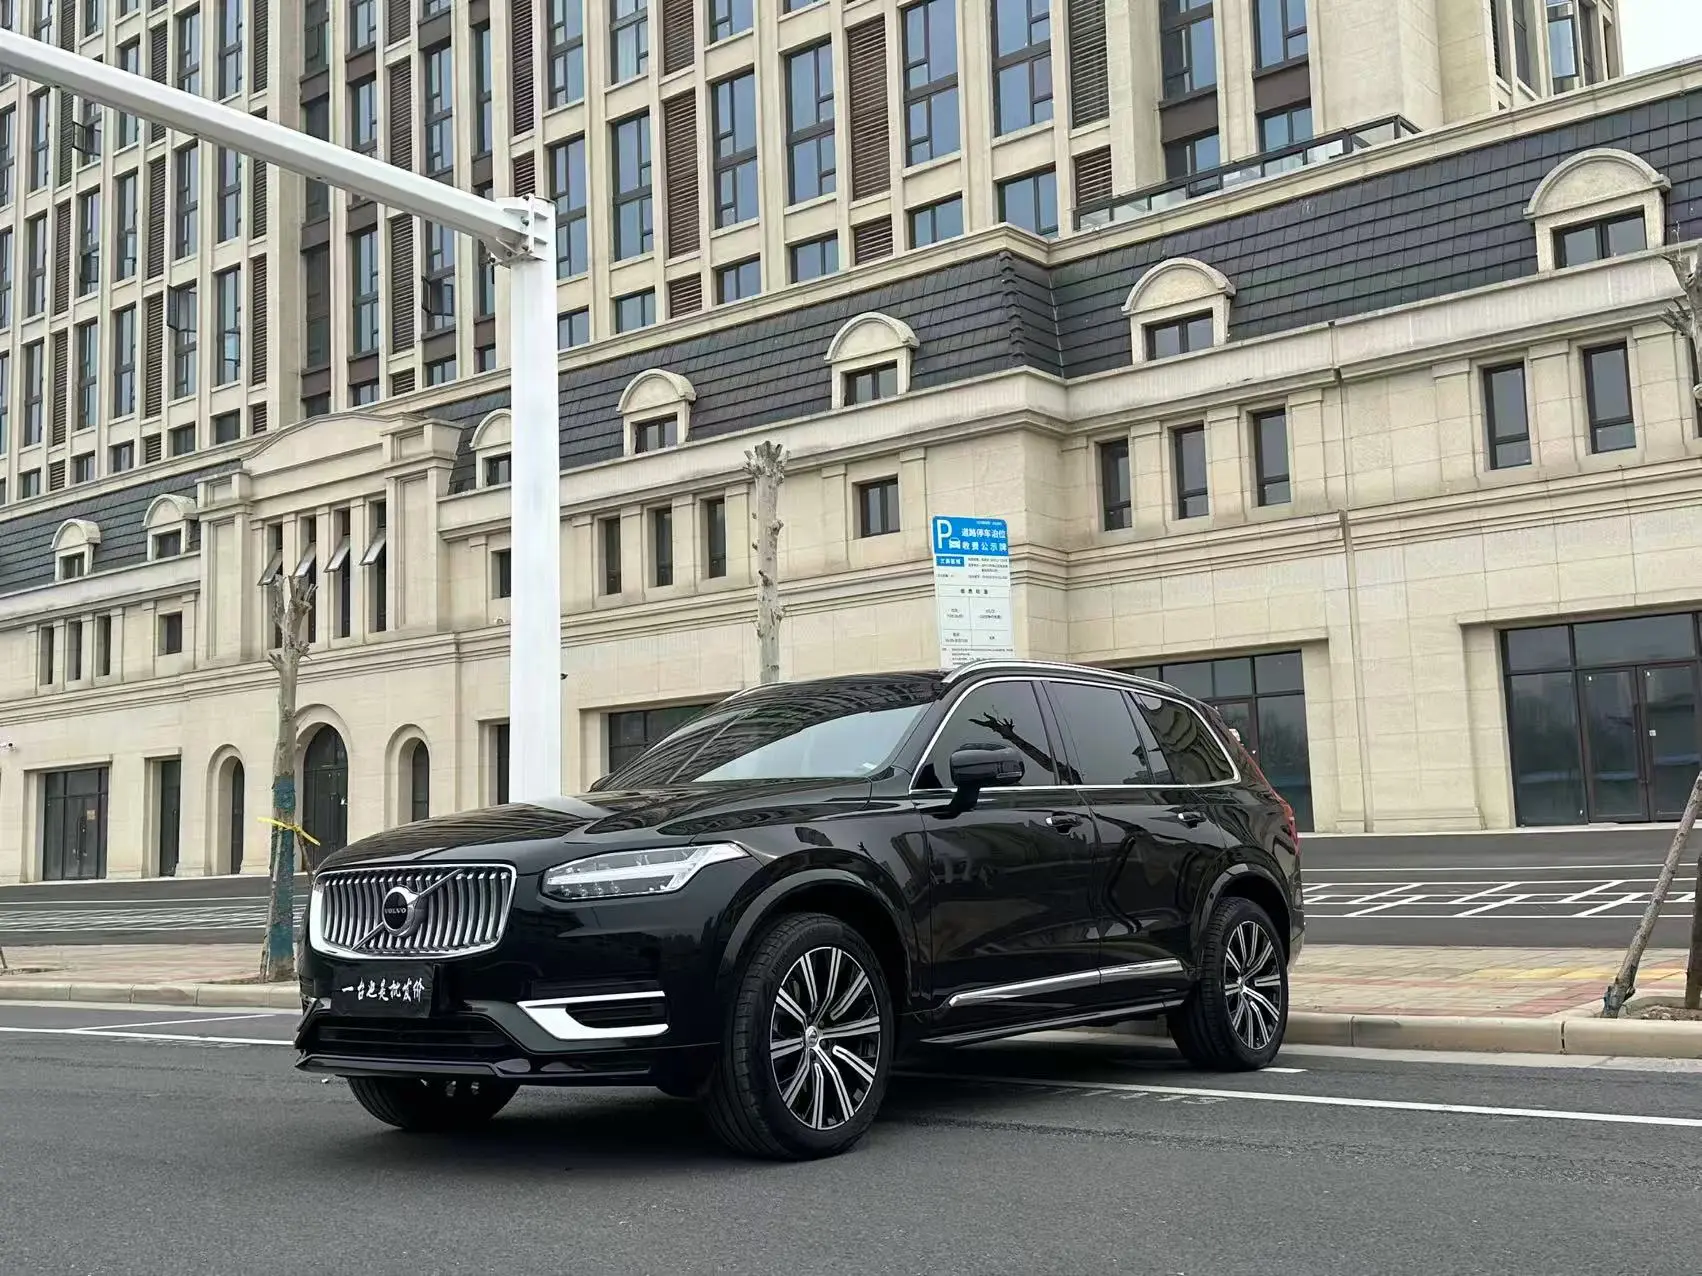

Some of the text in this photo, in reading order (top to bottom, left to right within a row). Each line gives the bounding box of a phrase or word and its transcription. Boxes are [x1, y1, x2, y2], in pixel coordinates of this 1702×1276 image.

[936, 520, 952, 549] P
[961, 528, 1006, 539] 道路停车泊位
[962, 541, 1007, 552] 收费公示牌
